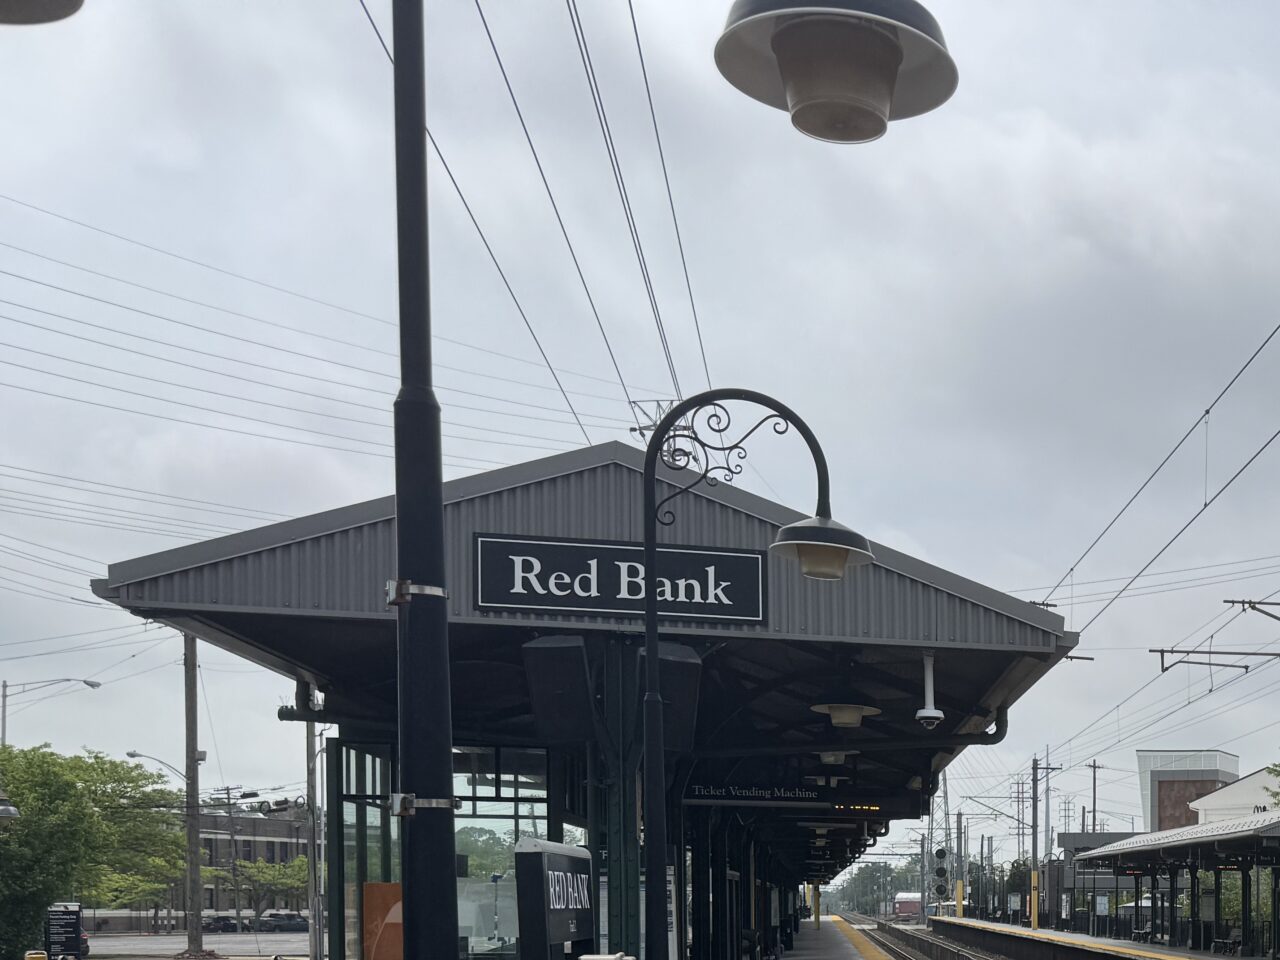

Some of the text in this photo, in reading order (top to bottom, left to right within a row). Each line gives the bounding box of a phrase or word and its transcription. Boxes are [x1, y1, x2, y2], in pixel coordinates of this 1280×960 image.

[508, 555, 733, 605] Red Bank
[692, 785, 818, 798] Ticket Vending Machine
[548, 870, 590, 909] RED BANK
